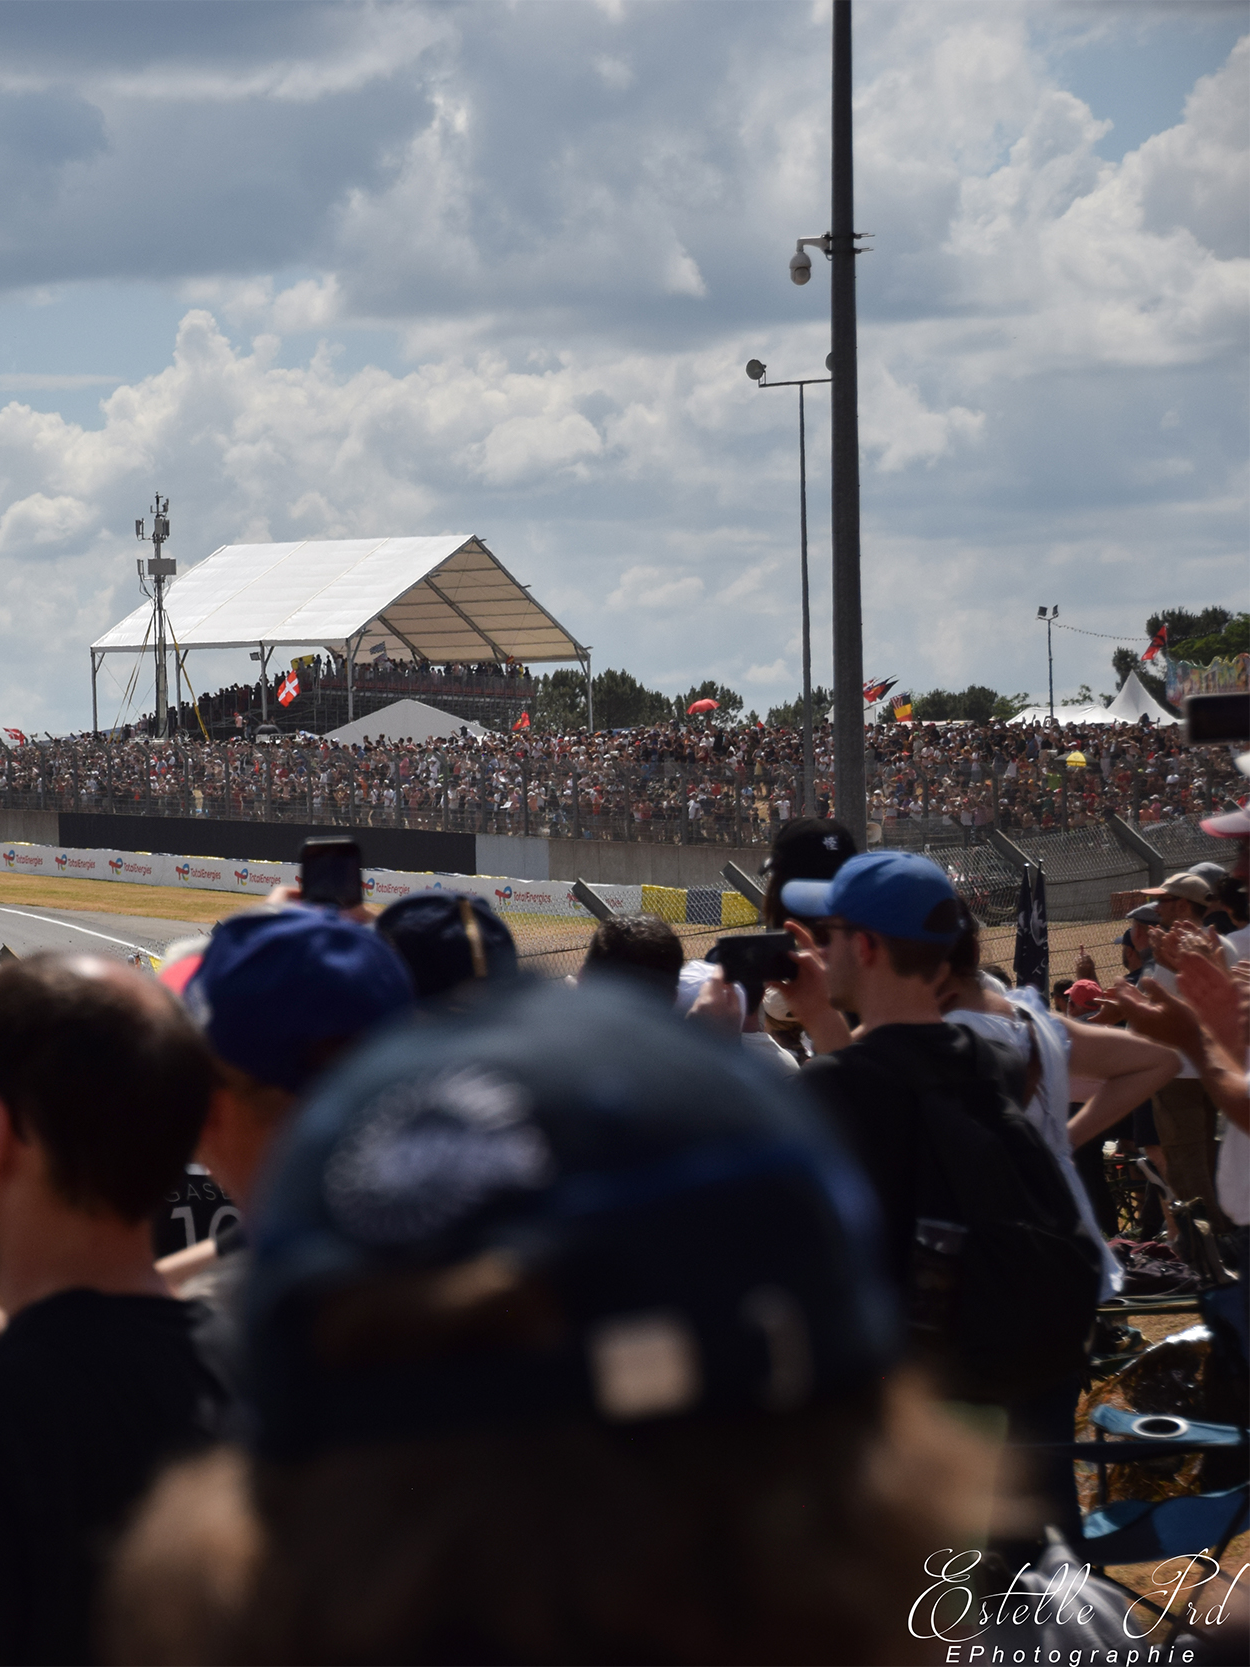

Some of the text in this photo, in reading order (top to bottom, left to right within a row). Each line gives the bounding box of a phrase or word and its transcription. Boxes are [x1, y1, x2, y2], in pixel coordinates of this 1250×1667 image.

[190, 867, 222, 882] TotalEnergies
[249, 872, 282, 887] TotalEnergies
[375, 882, 411, 897] TotalEnergies
